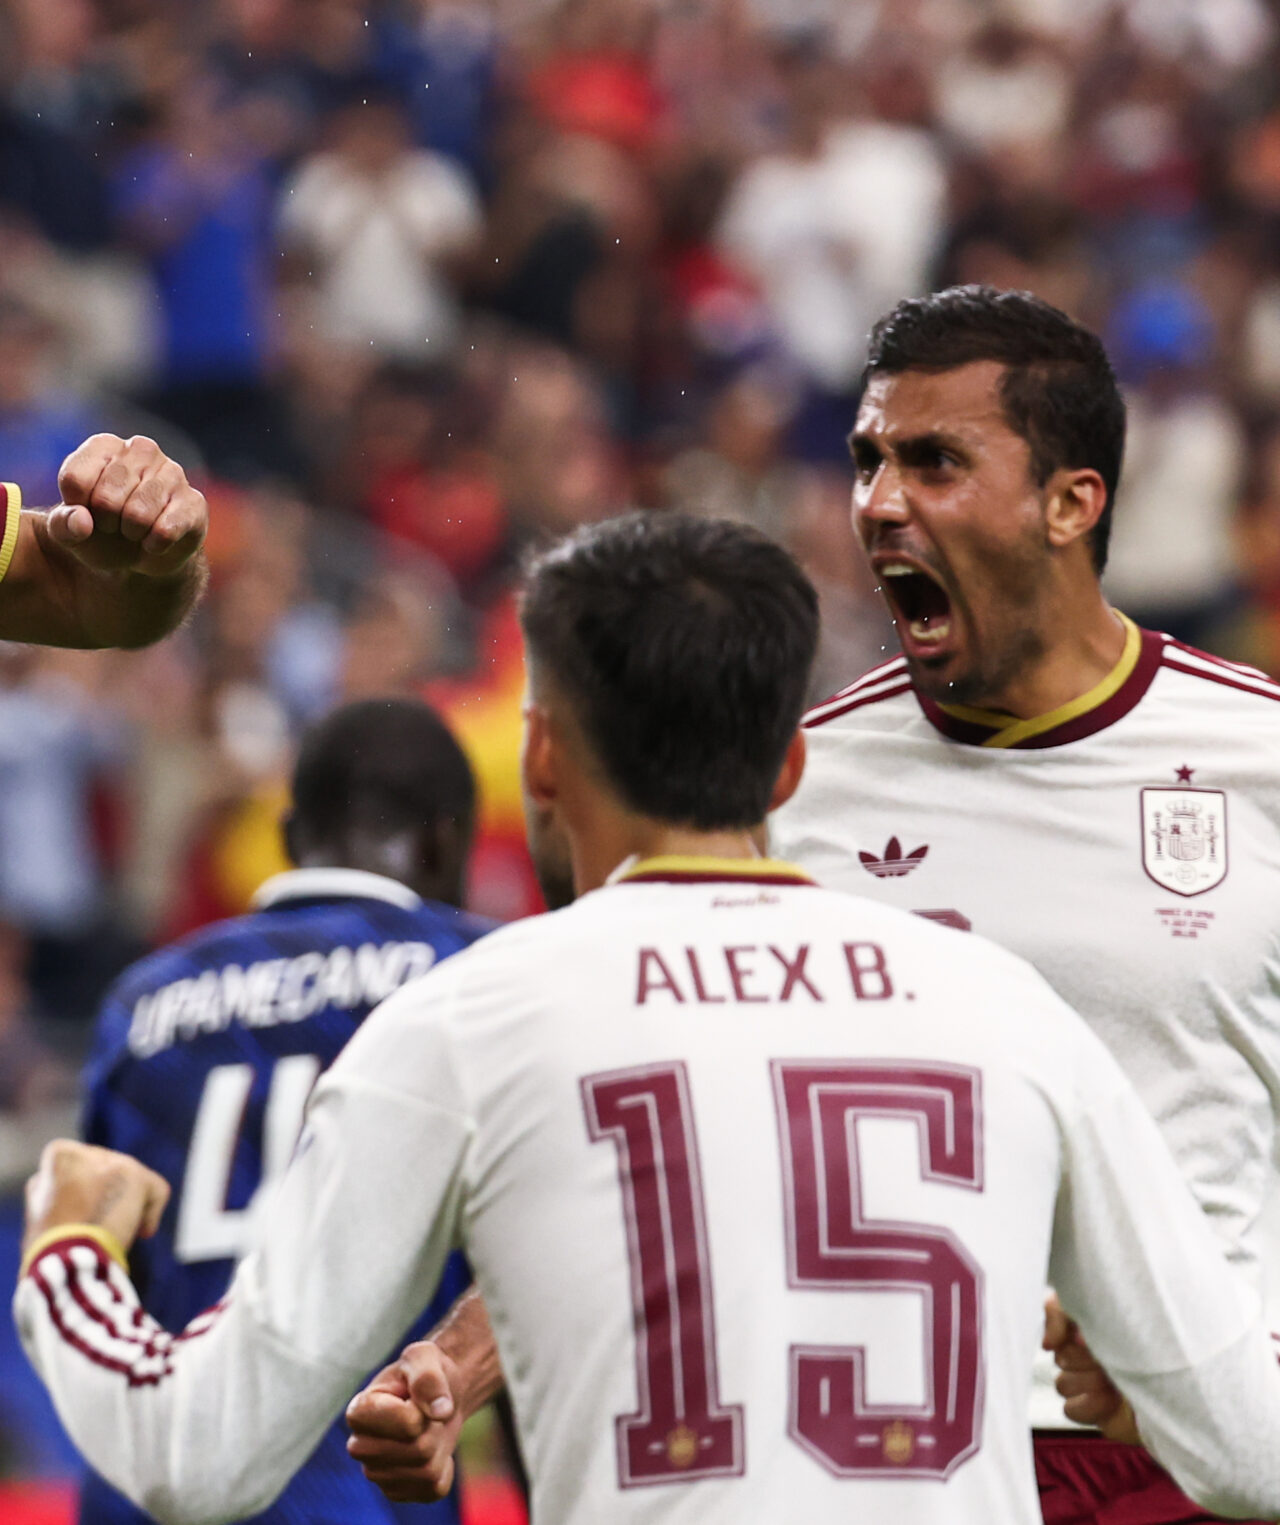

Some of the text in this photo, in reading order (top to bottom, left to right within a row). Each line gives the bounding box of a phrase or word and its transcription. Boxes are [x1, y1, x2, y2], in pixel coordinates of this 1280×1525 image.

[635, 940, 916, 1005] ALEX B.
[579, 1057, 985, 1490] 15
